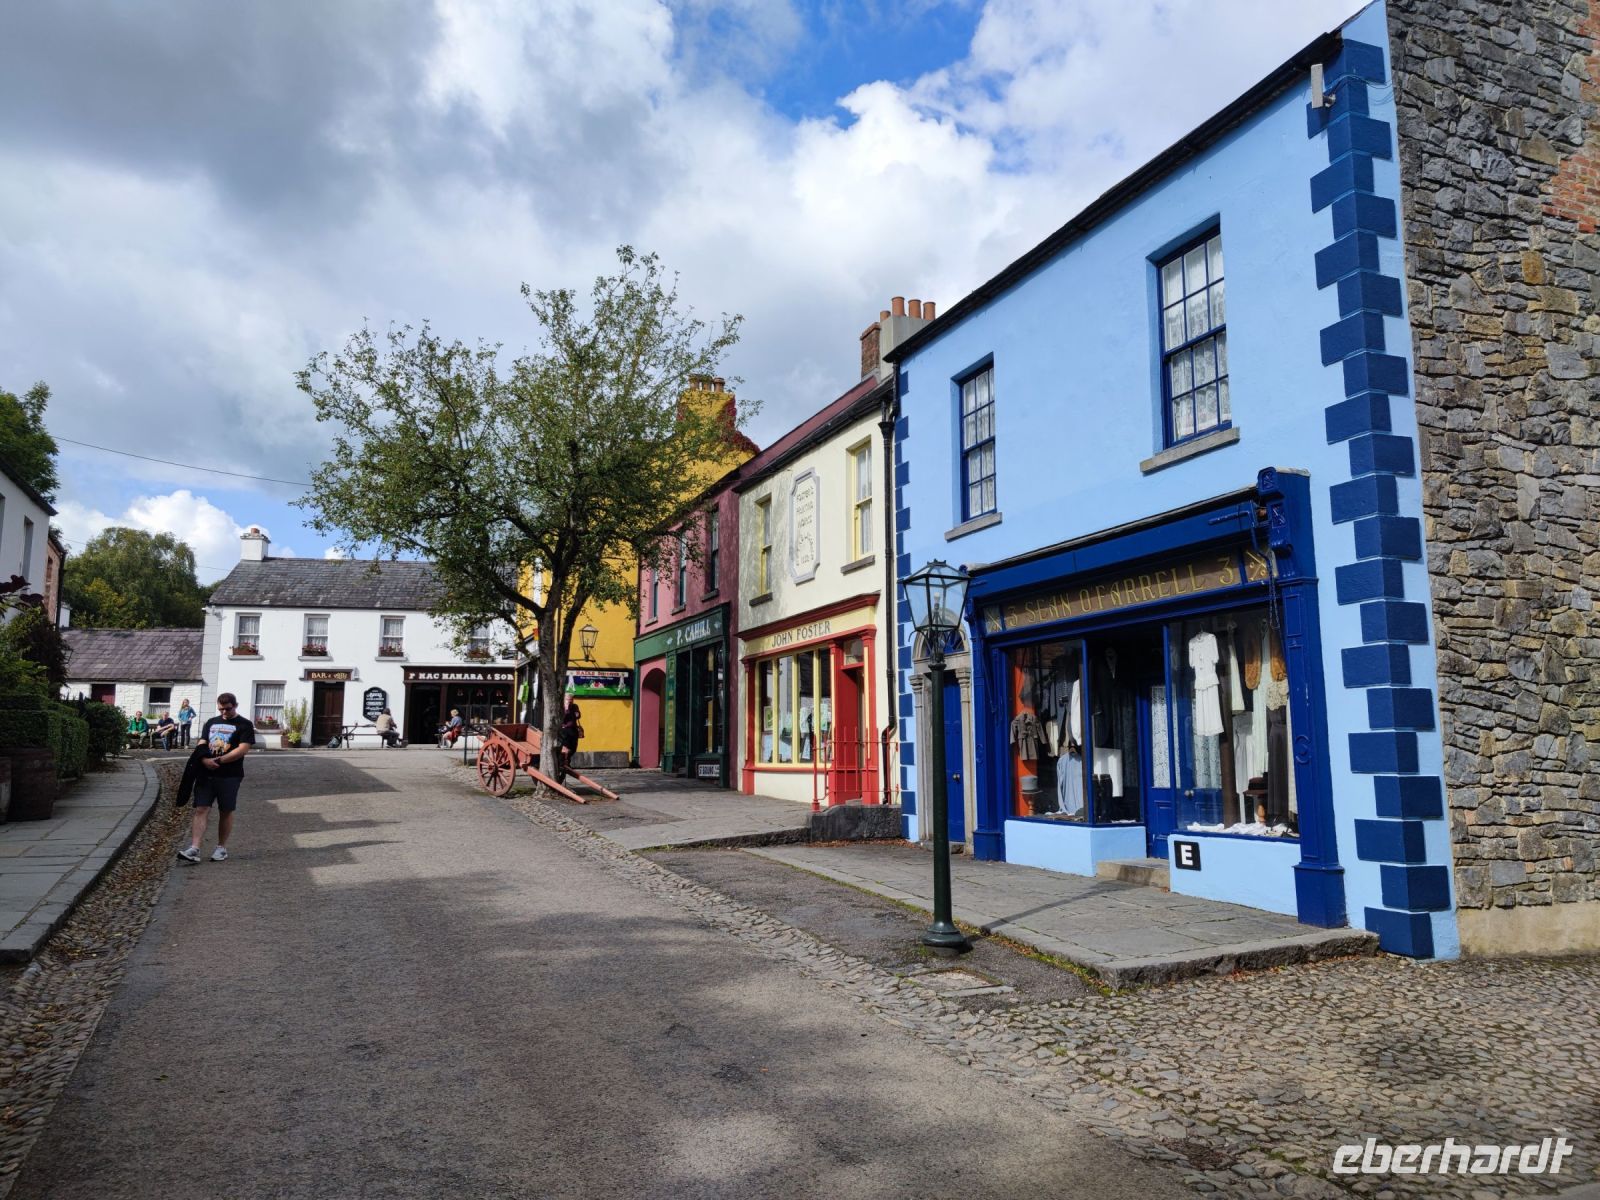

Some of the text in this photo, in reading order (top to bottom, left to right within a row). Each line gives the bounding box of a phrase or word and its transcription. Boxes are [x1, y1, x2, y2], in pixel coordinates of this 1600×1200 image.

[1218, 557, 1235, 586] 3
[771, 620, 831, 648] JOHN FOSTER
[1180, 844, 1194, 866] E
